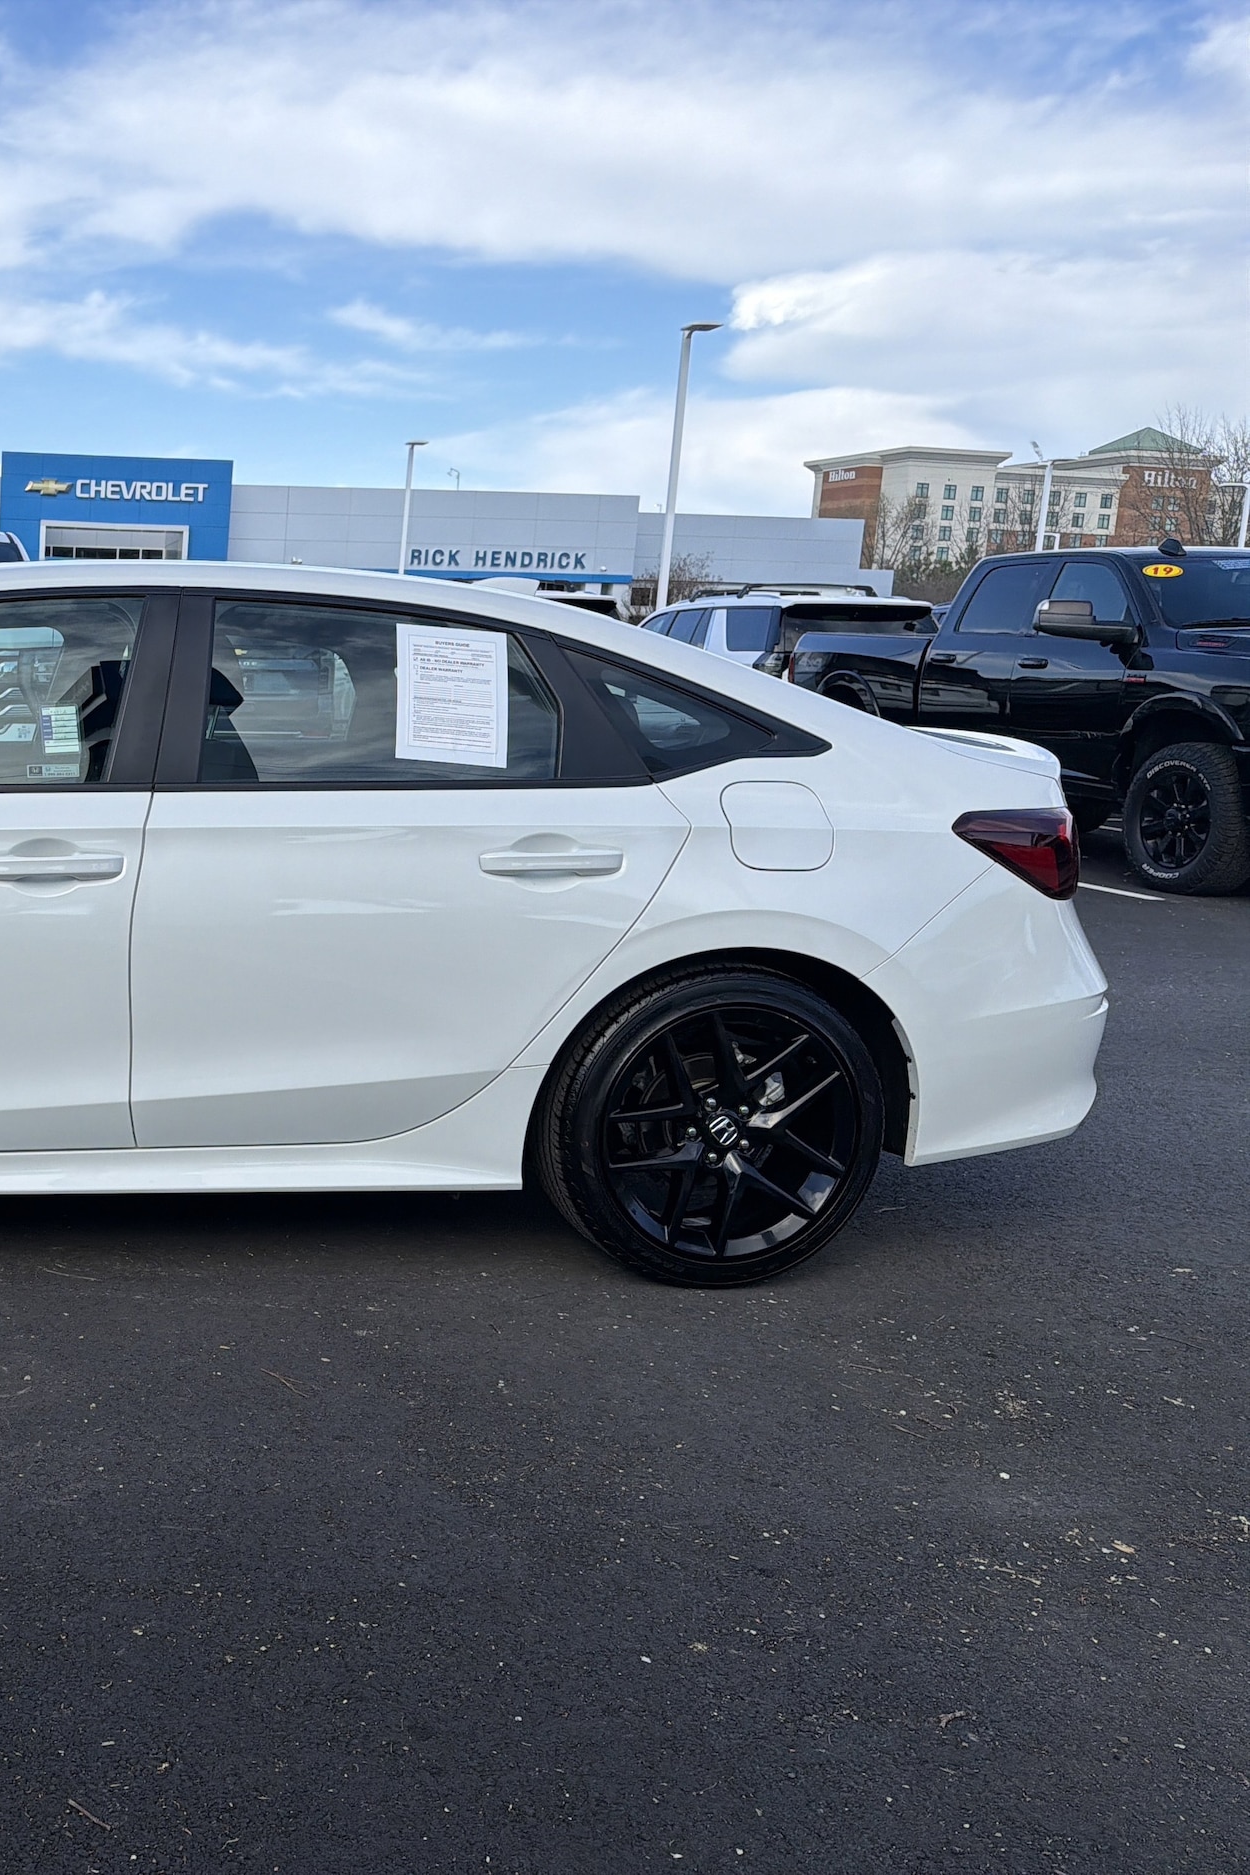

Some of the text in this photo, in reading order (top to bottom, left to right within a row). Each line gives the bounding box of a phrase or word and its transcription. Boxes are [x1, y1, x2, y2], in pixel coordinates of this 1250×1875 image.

[828, 469, 856, 482] Hilton
[1143, 469, 1197, 489] Hilton
[75, 479, 209, 502] CHEVROLET
[410, 548, 587, 570] RICK HENDRICK
[1152, 566, 1174, 576] 19
[1146, 760, 1197, 779] DISCOVERER
[1141, 863, 1179, 879] COOPER
